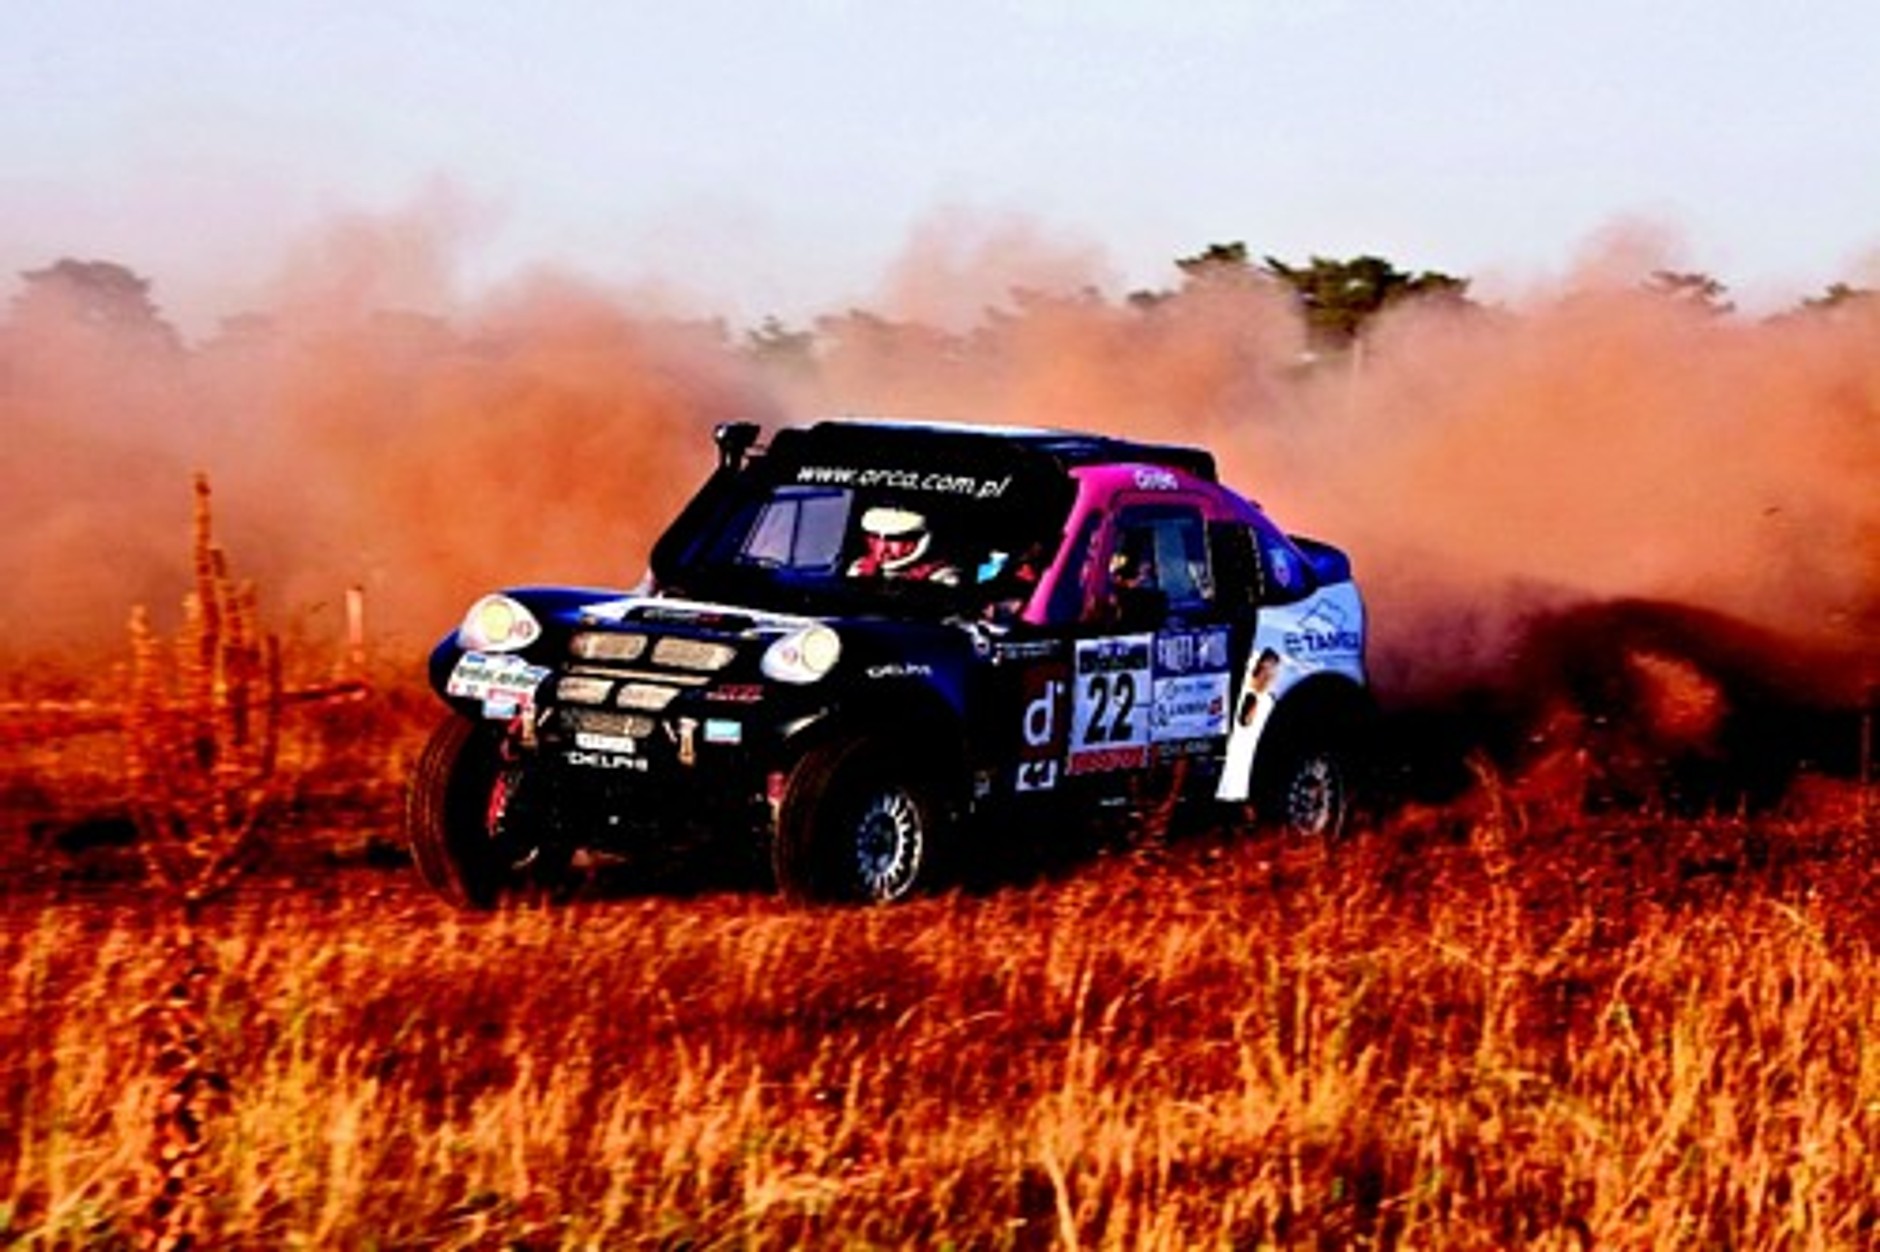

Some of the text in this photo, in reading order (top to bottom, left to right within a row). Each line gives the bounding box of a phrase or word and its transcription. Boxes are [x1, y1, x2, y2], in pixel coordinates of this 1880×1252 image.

[797, 465, 1013, 498] www.orca.com.pl
[1084, 672, 1134, 746] 22
[567, 751, 648, 771] DELPHI
